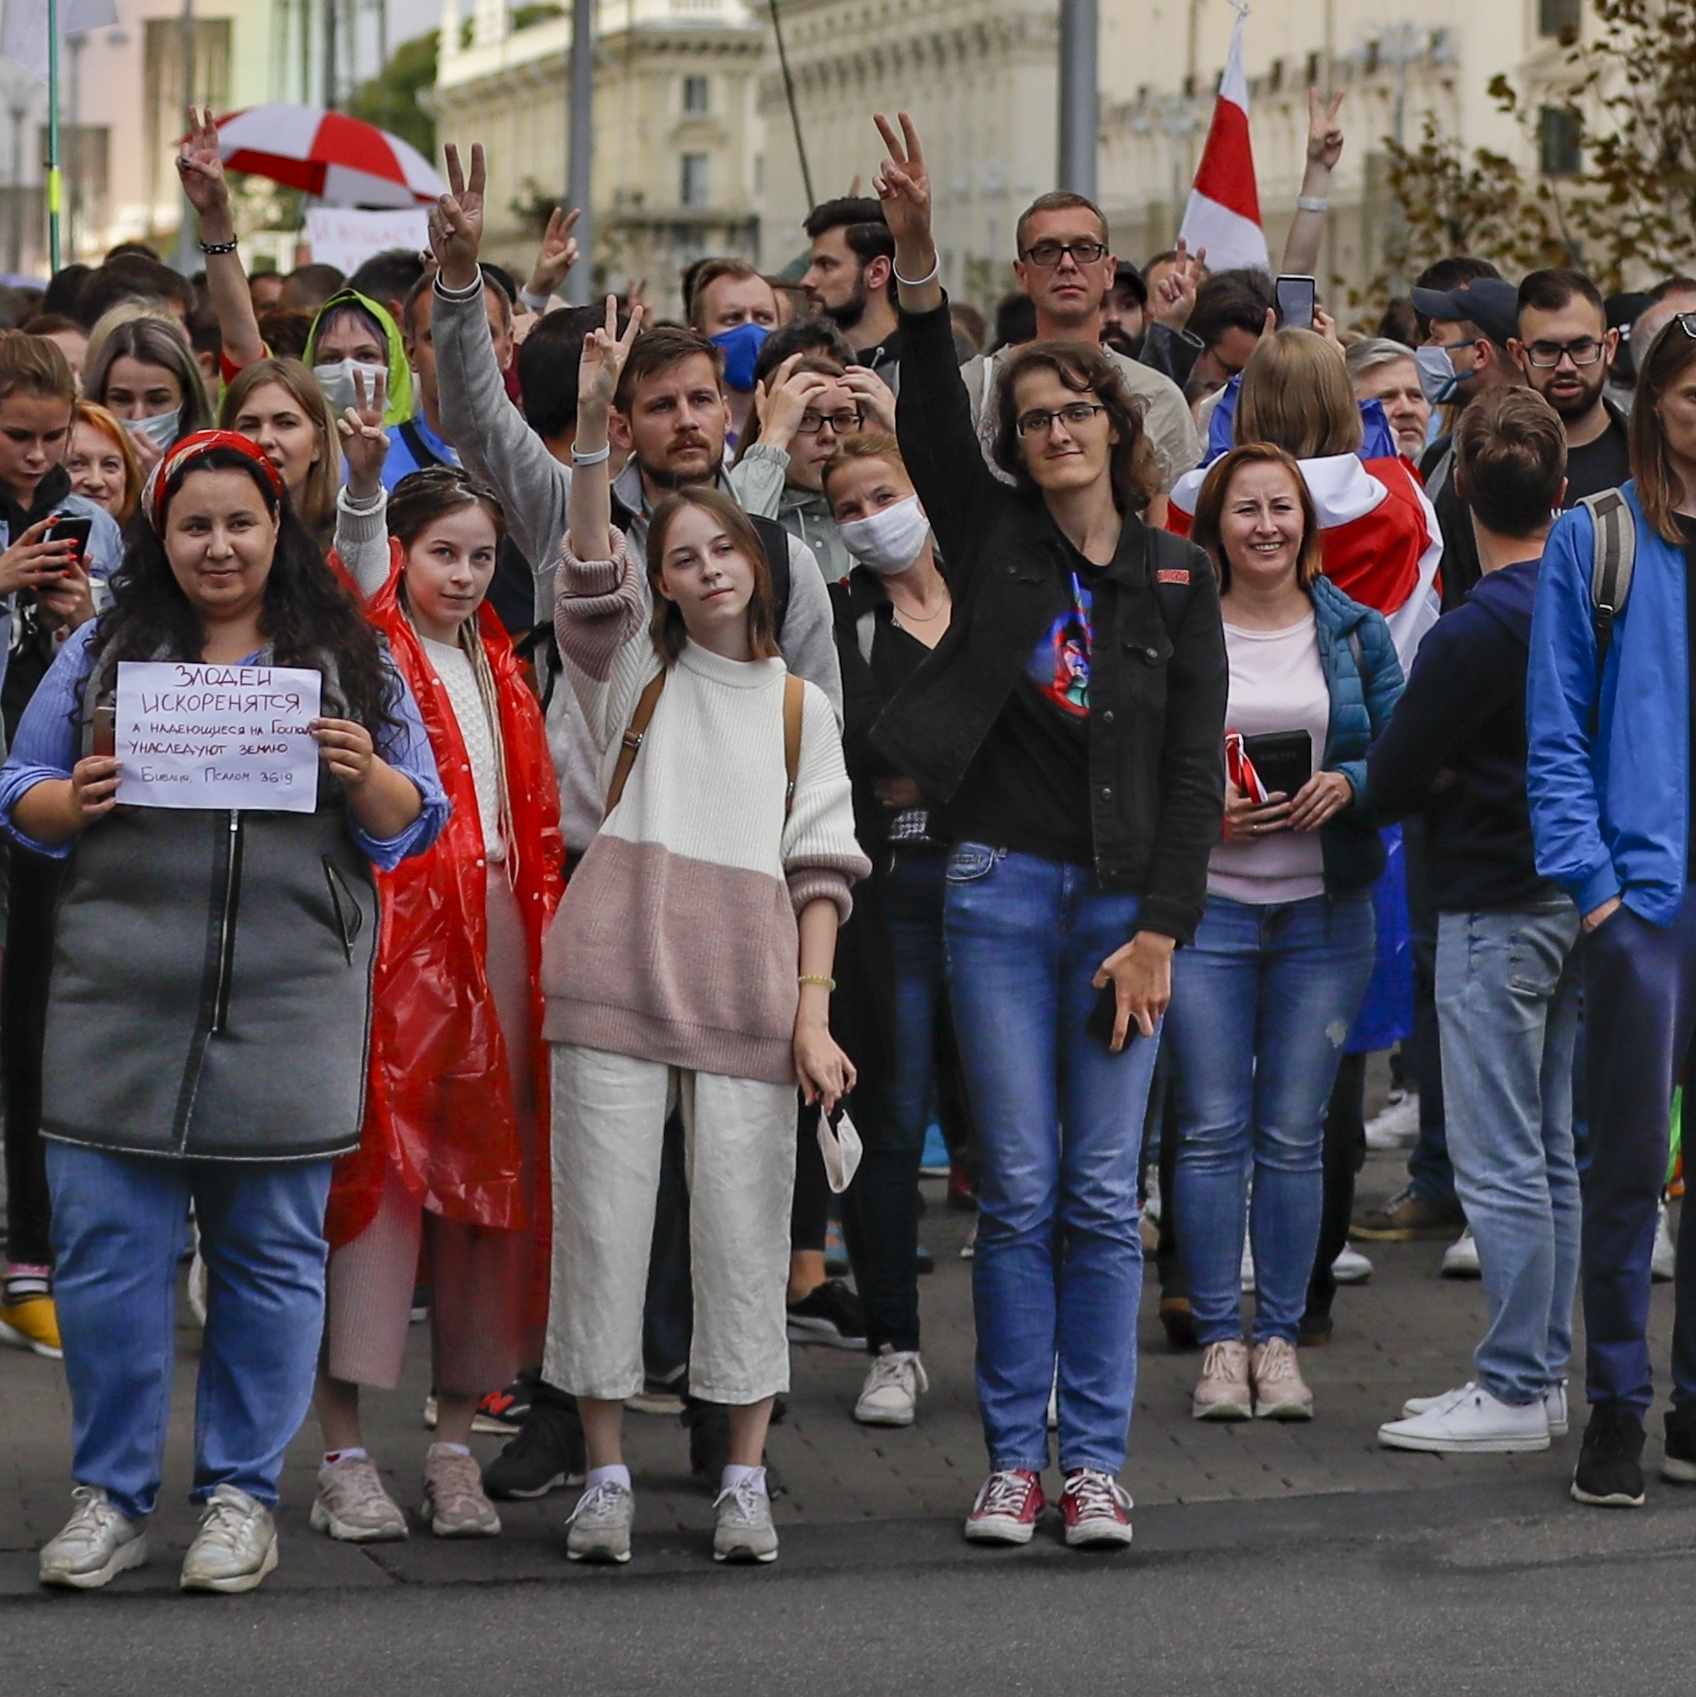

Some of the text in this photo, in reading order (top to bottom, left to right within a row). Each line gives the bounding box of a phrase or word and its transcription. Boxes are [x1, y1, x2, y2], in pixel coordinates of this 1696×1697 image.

[174, 665, 271, 687] ЗЛОДЕИ
[142, 693, 303, 714] ИСКОРЕНЯТСЯ,
[129, 740, 227, 757] УНАСЛЕДУЮТ
